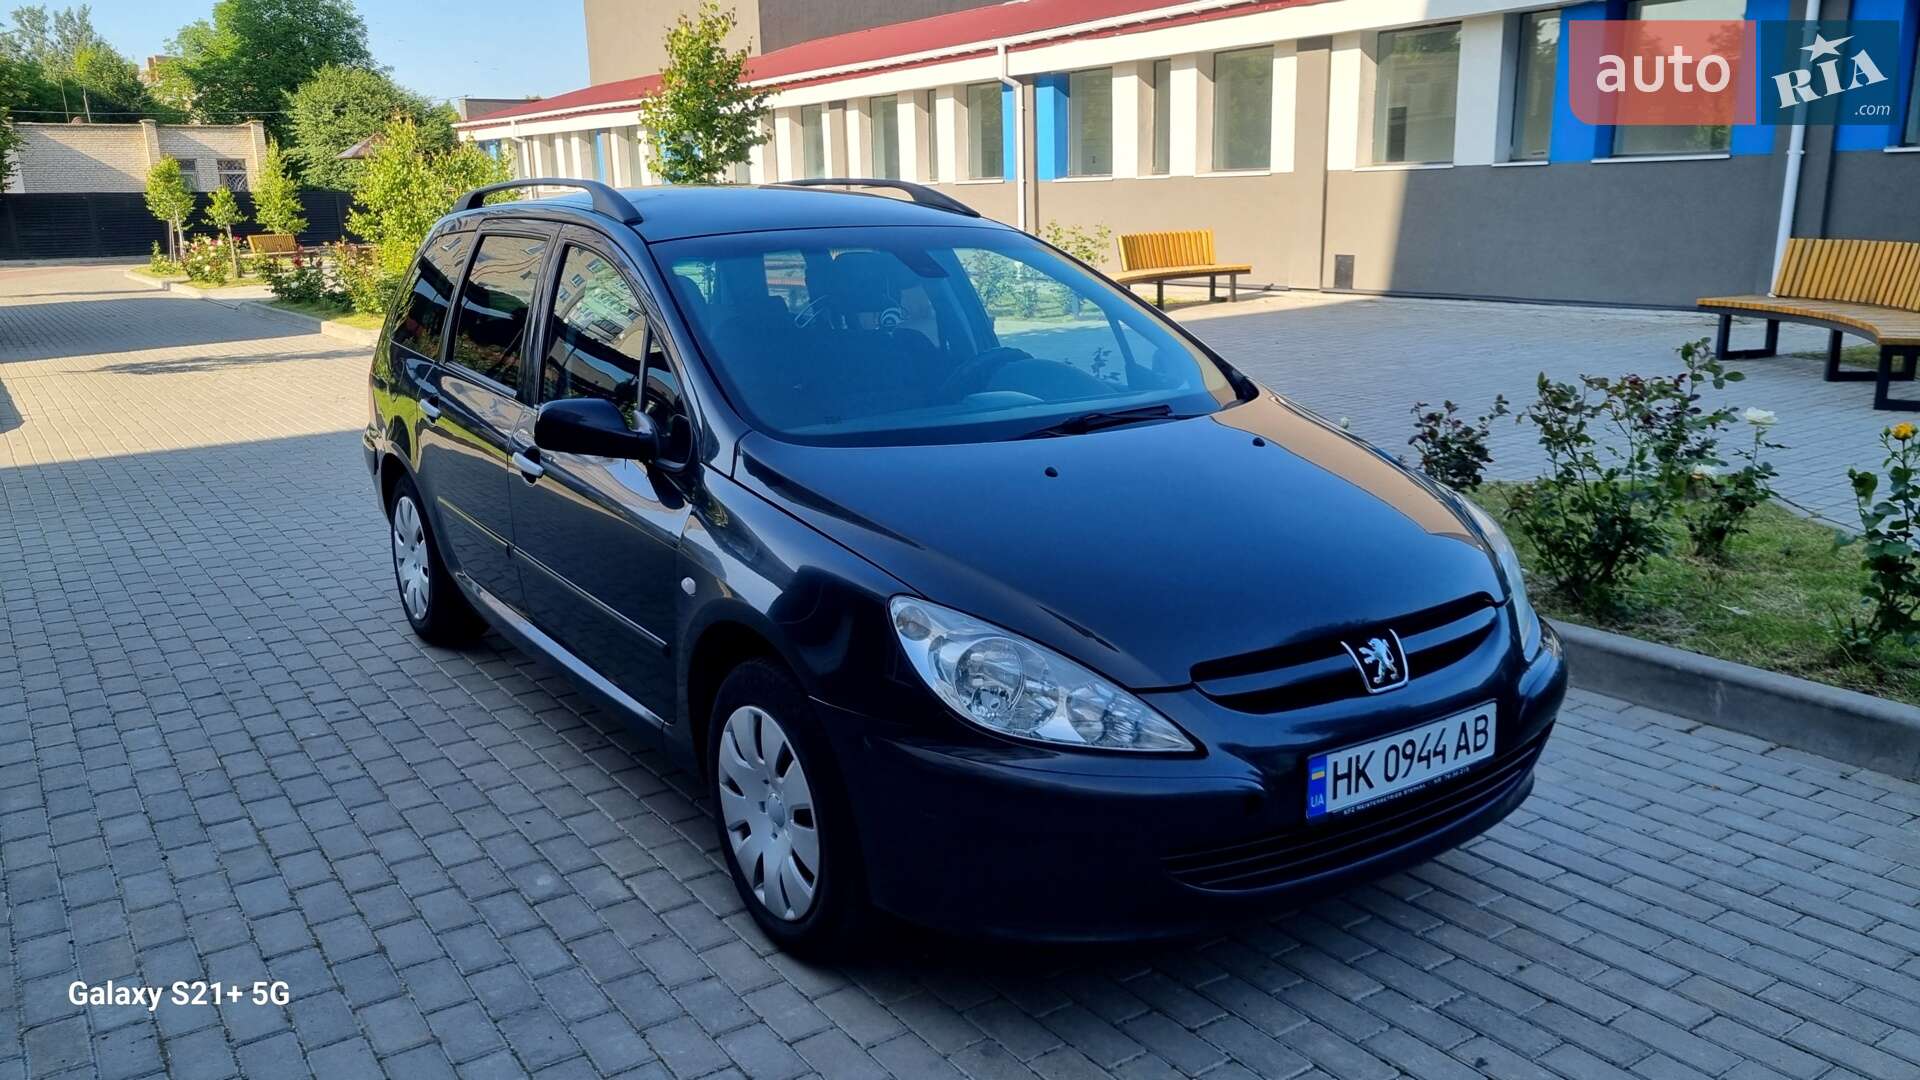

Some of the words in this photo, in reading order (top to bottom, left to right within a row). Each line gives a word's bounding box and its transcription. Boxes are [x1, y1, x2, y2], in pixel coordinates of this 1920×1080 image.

[1332, 750, 1376, 800] HK
[1383, 727, 1448, 783] 0944
[1453, 714, 1489, 760] AB
[1310, 793, 1325, 808] UA
